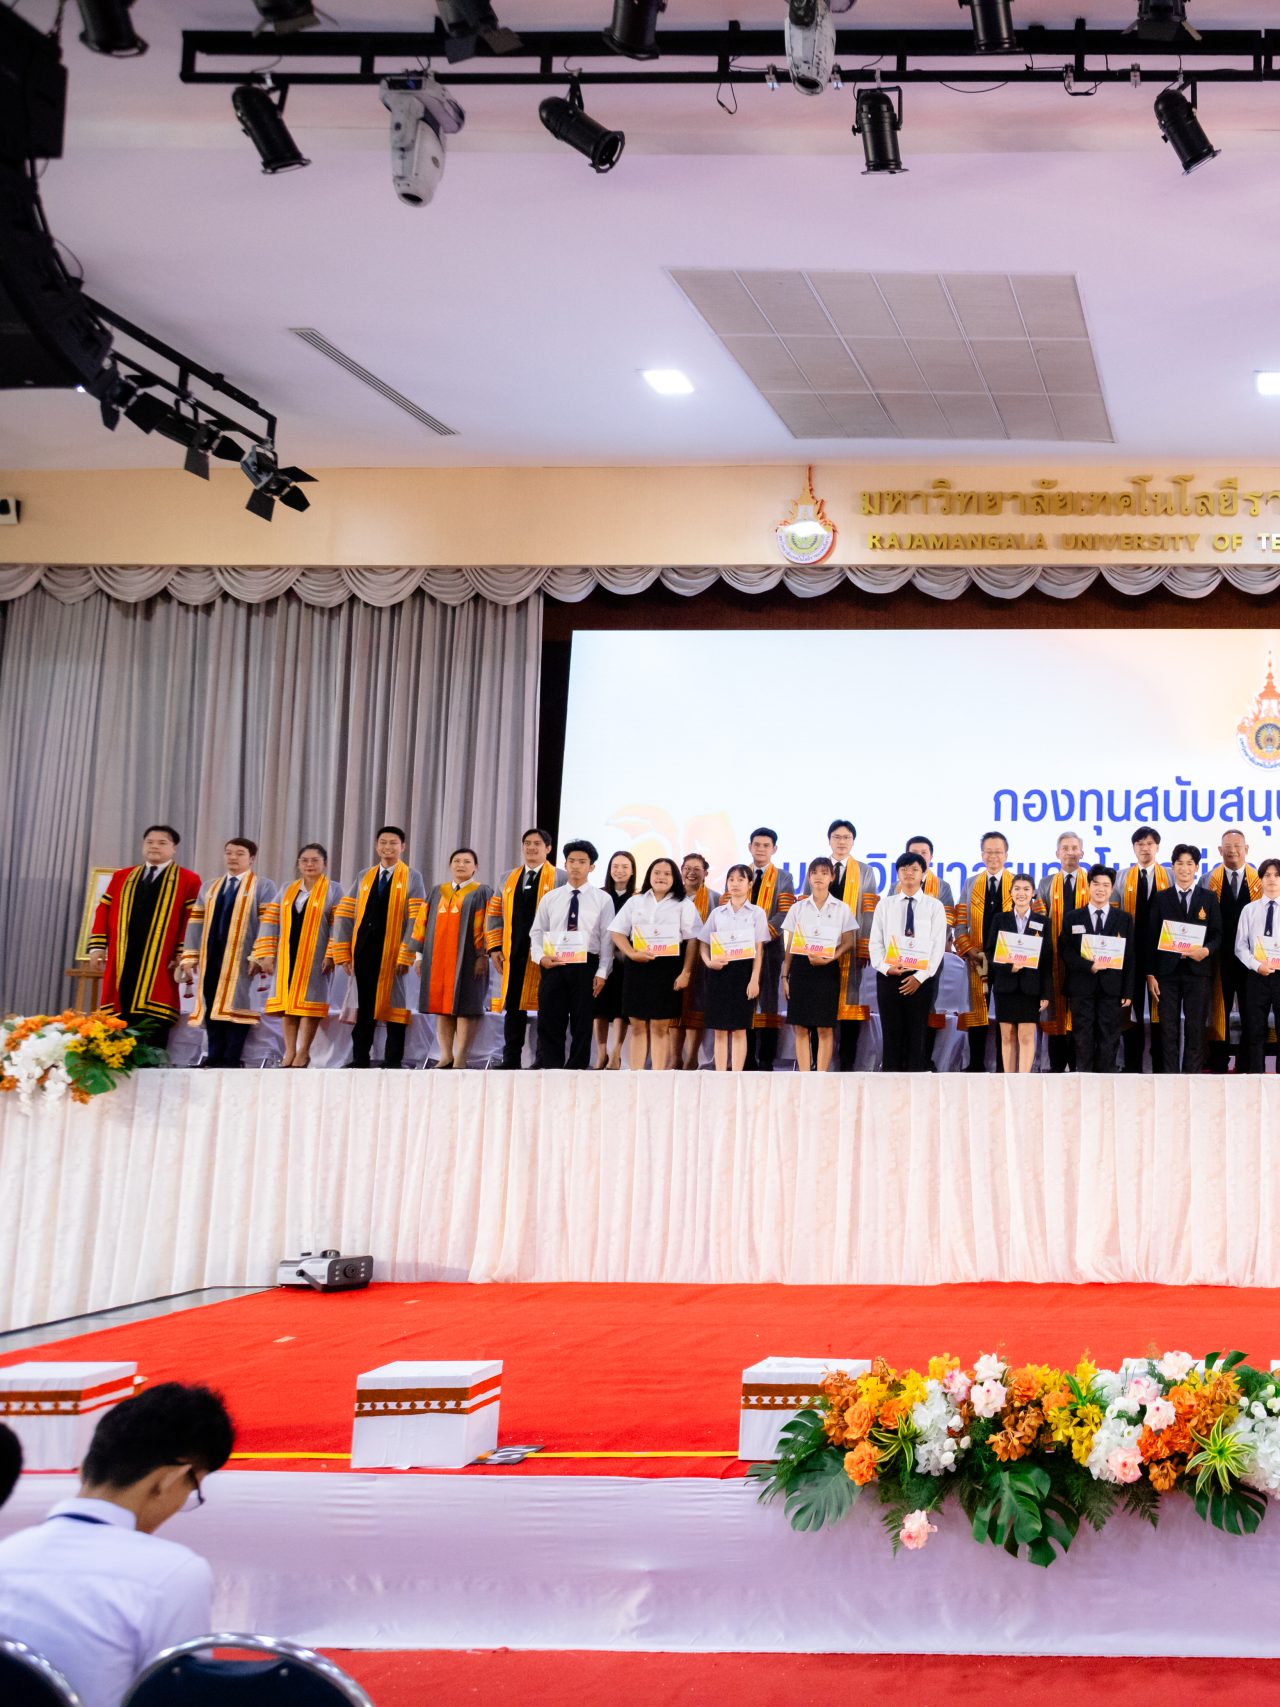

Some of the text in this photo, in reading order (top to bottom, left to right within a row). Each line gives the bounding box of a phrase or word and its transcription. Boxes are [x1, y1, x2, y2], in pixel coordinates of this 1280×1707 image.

[867, 532, 1048, 551] RAJAMANGALA
[1061, 533, 1200, 552] UNIVERSITY
[1212, 533, 1244, 552] OF
